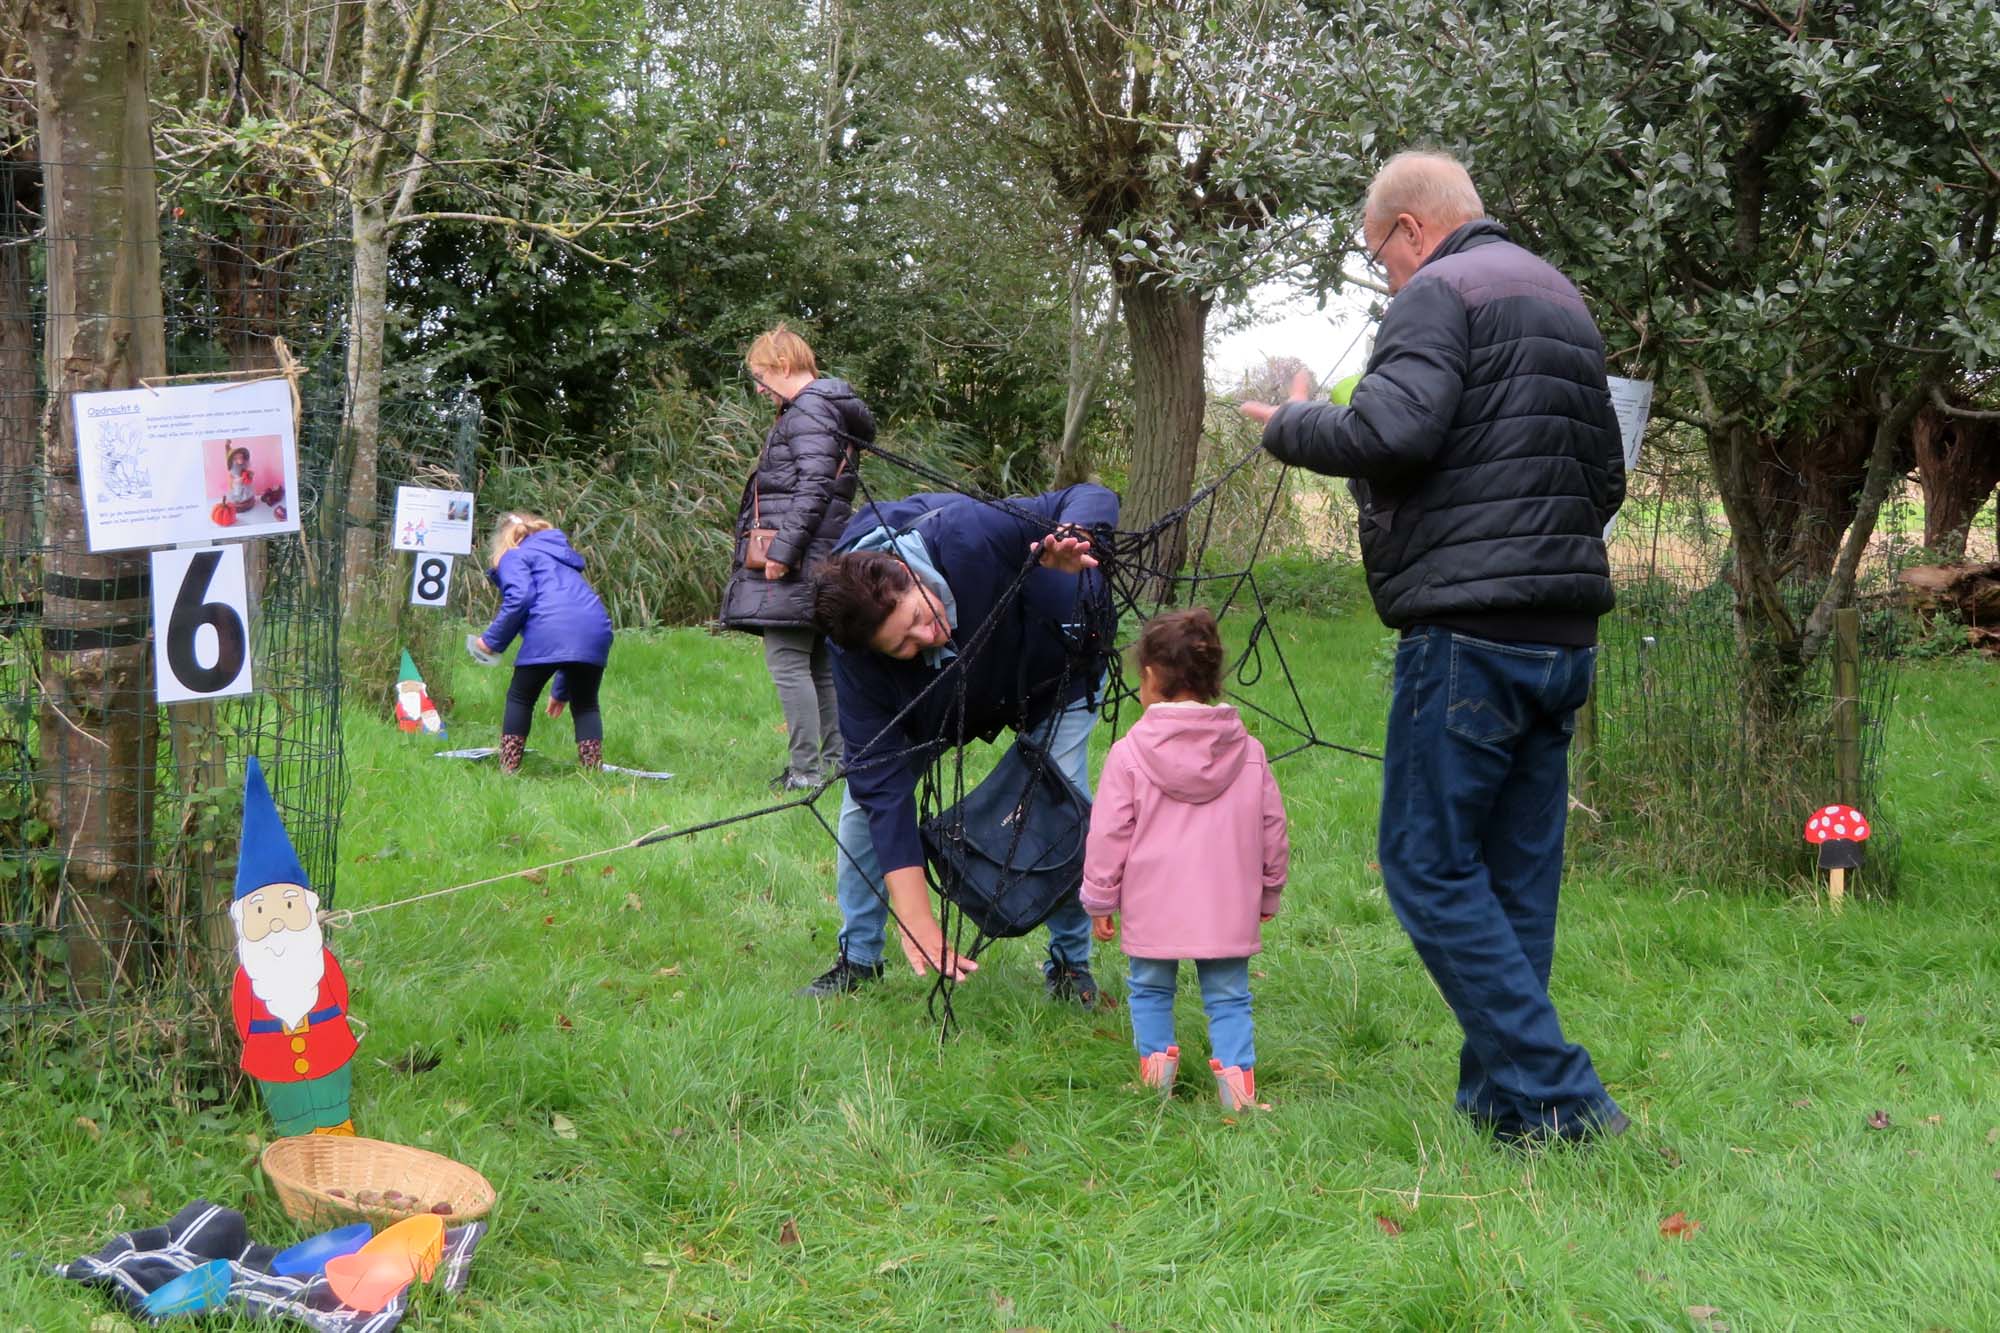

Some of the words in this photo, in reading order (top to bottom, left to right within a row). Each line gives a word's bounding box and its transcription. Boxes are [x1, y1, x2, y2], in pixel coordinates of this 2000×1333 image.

[87, 404, 131, 417] Opdracht
[417, 558, 447, 601] 8
[167, 550, 246, 693] 6
